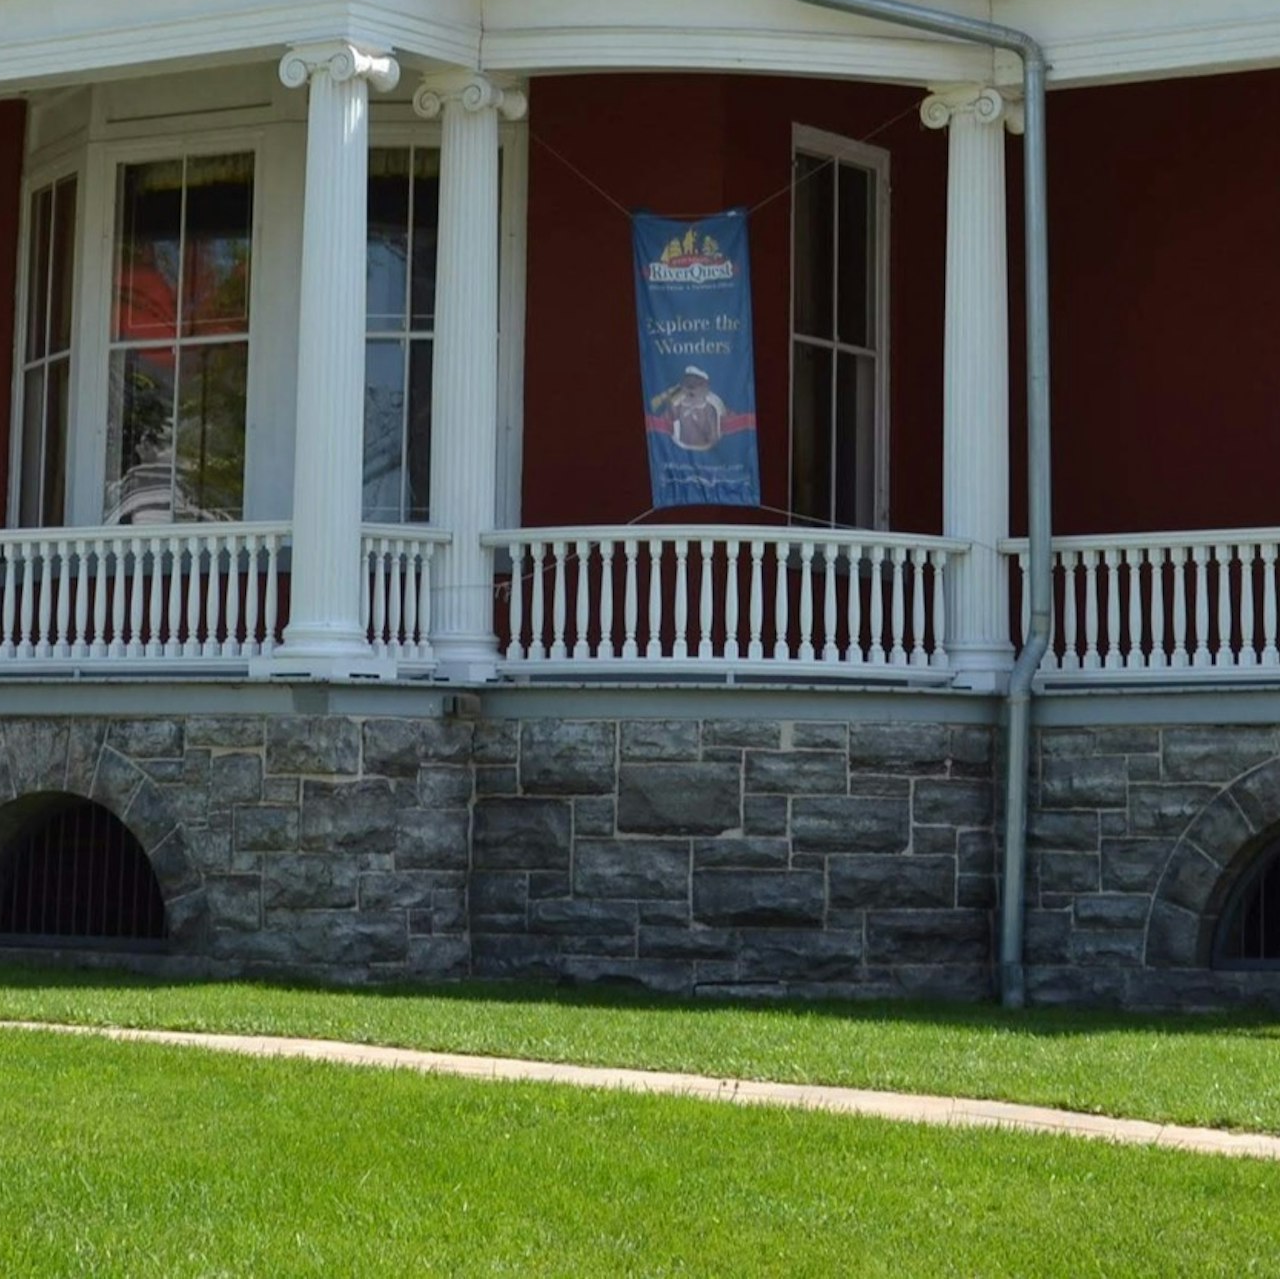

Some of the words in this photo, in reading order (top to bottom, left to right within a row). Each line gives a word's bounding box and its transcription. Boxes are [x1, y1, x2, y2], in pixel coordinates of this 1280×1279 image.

[651, 261, 732, 282] RiverQuest
[647, 314, 710, 336] Explore
[716, 313, 741, 331] the
[655, 337, 731, 355] Wonders
